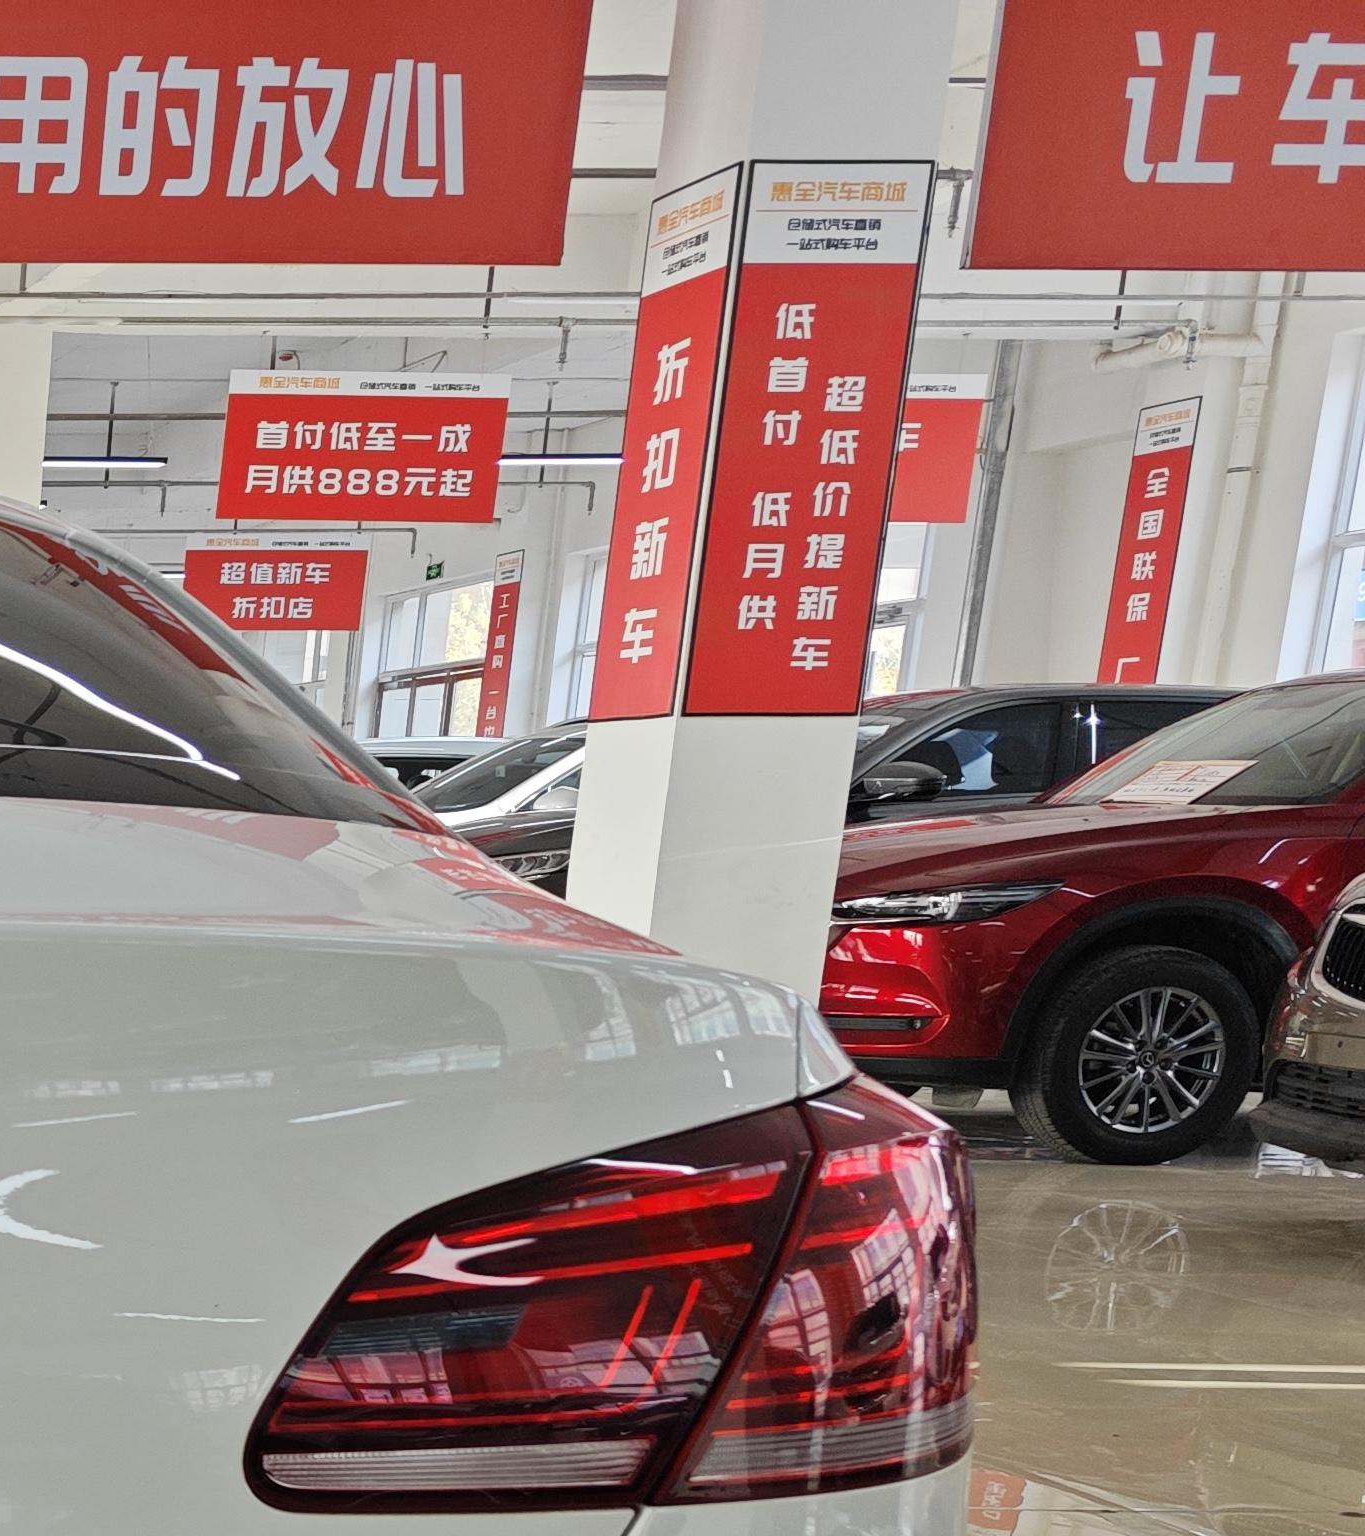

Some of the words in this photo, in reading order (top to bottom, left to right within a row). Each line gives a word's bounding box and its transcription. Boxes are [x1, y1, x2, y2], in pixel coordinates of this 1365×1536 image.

[771, 181, 908, 203] 惠全汽车商城
[258, 376, 342, 390] 惠全汽车商城
[255, 420, 472, 454] 首付低至一成
[244, 464, 474, 498] 月供888元起
[619, 336, 693, 666] 折扣新车
[789, 375, 867, 672] 超低价提新车
[1125, 466, 1171, 623] 全国联保
[219, 562, 332, 585] 超值新车
[231, 596, 314, 619] 折扣店
